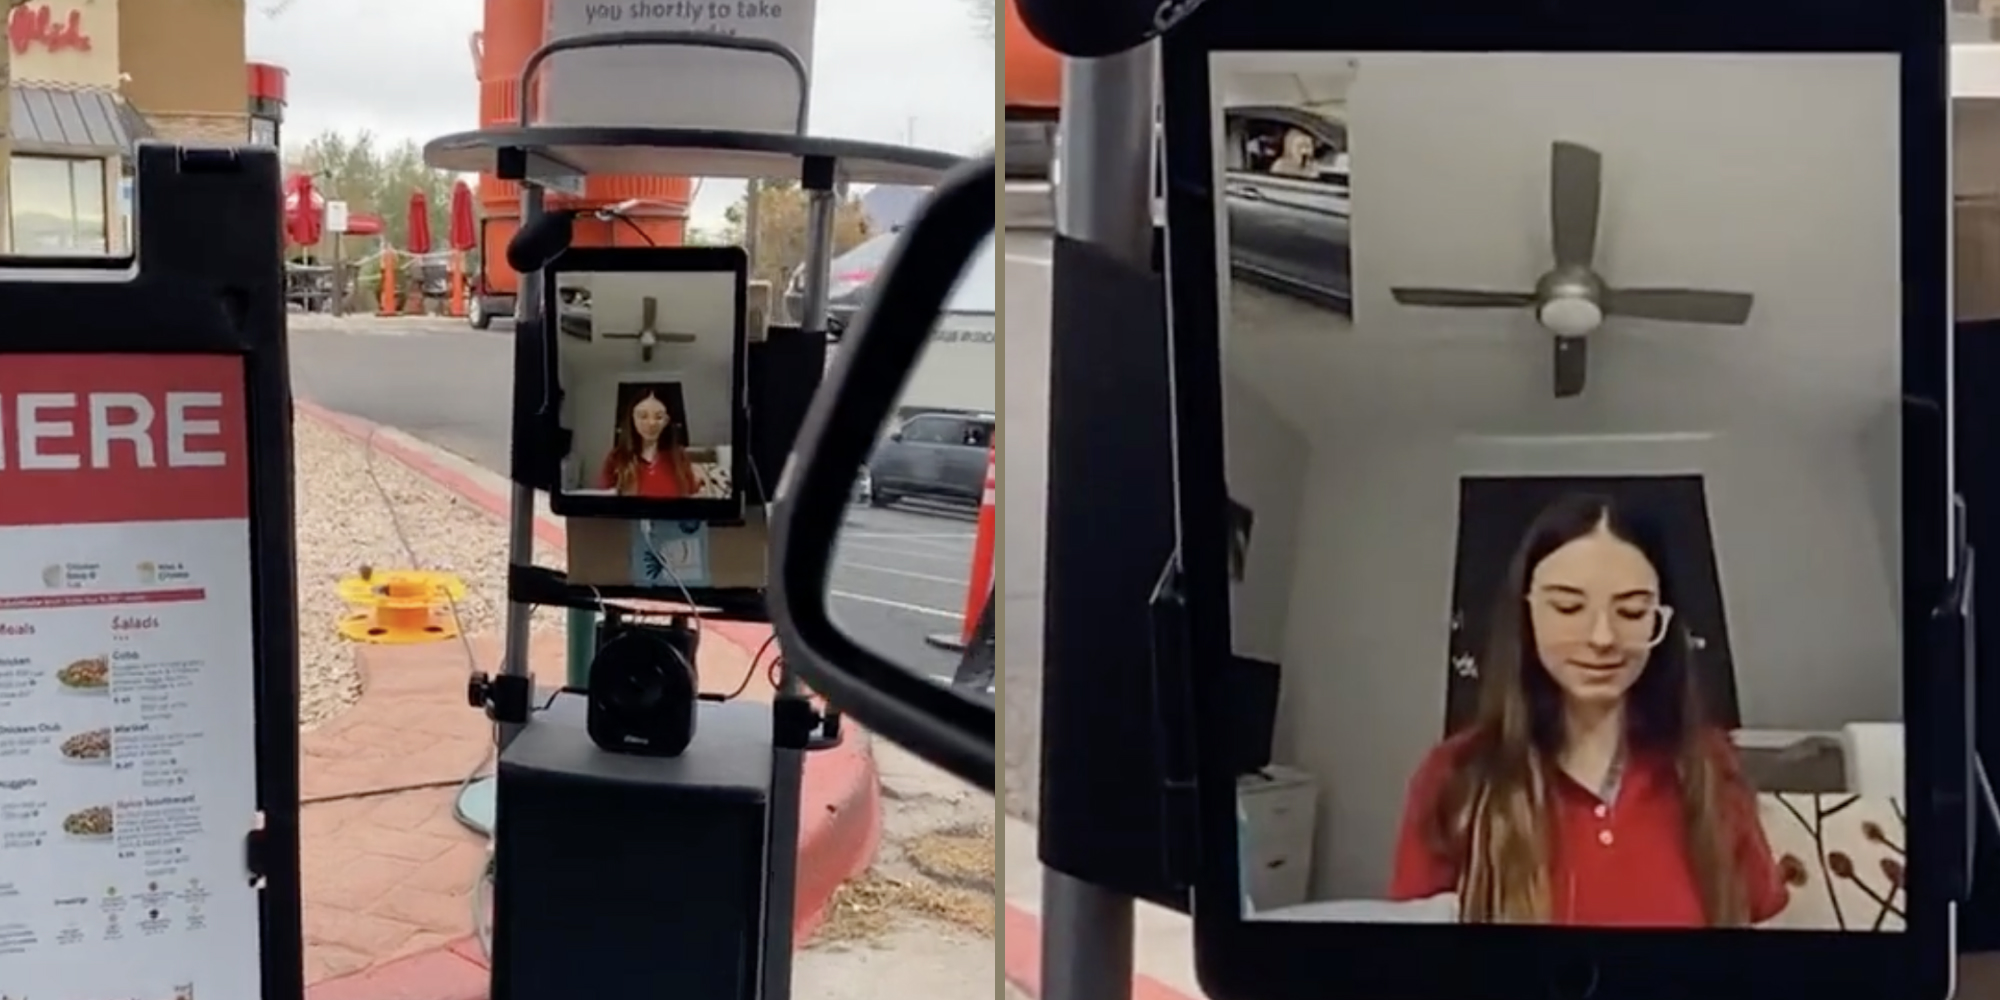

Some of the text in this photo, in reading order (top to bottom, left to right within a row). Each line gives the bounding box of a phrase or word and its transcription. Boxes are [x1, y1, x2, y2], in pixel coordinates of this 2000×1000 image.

[585, 0, 782, 25] you shortly to take
[0, 391, 227, 470] ERE
[111, 615, 160, 630] Salads
